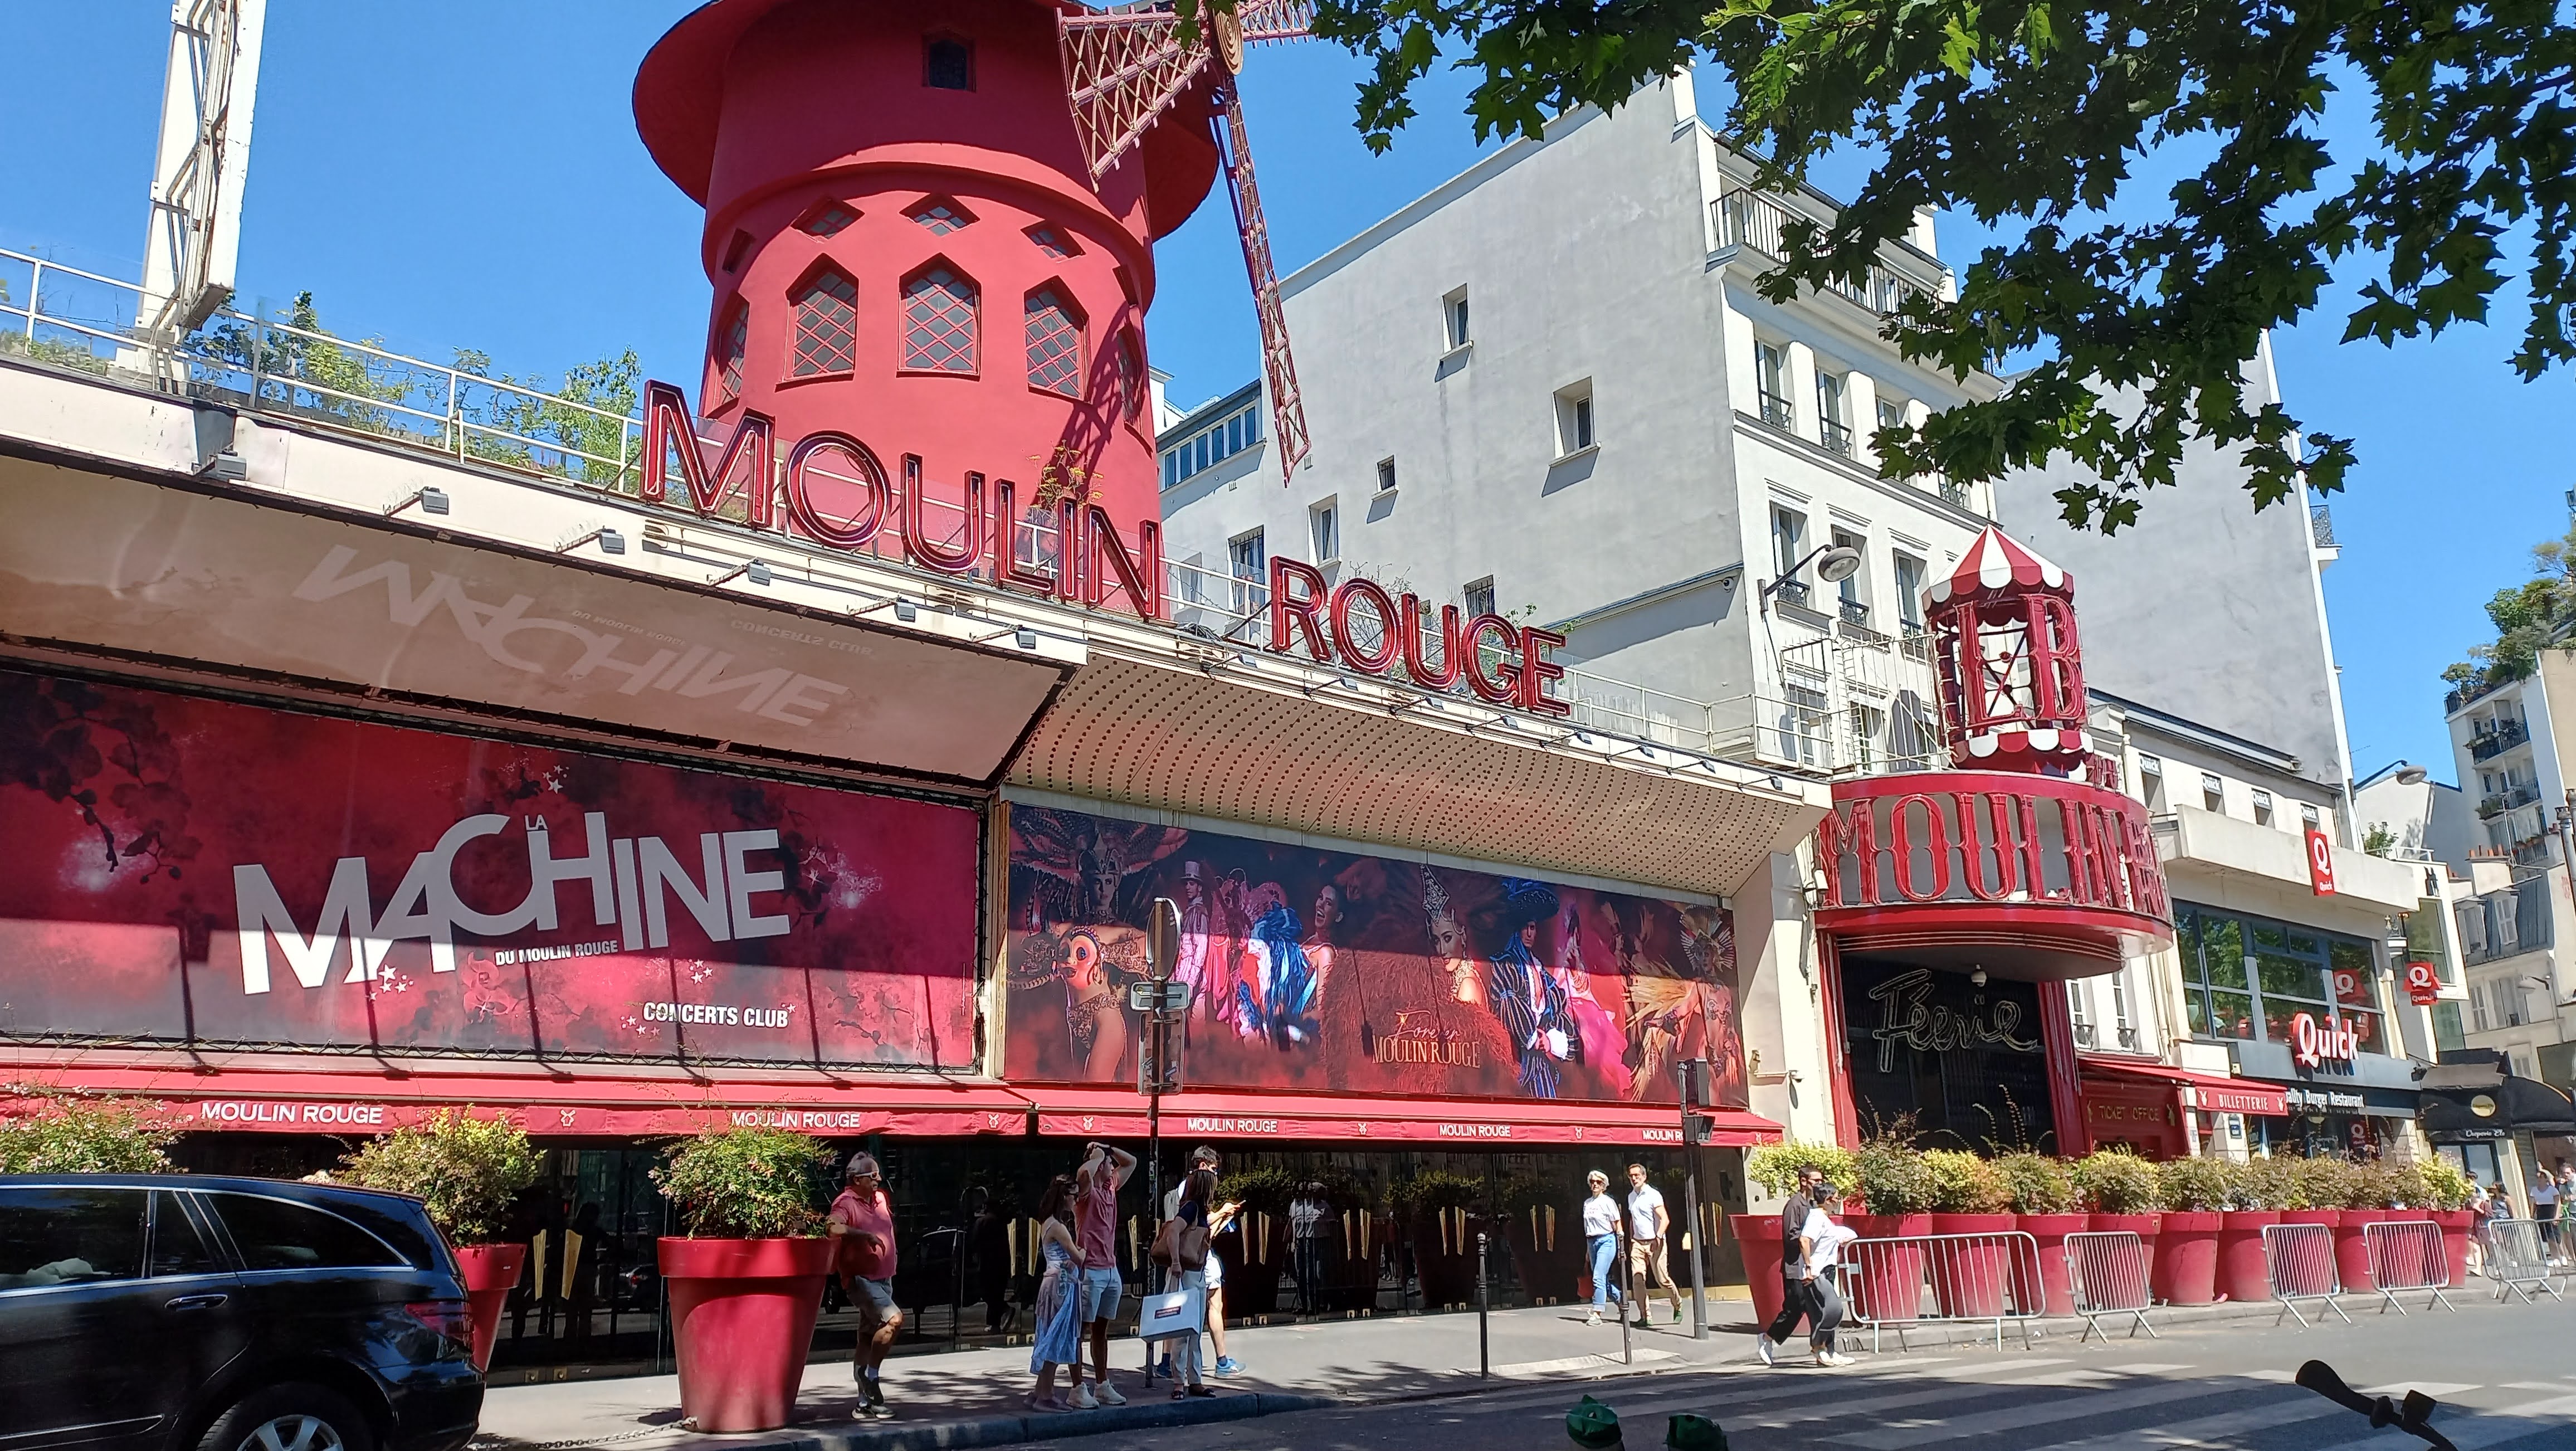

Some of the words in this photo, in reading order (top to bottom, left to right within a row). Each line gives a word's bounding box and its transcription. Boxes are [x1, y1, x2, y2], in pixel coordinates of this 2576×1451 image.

[640, 379, 1160, 621] MOULIN
[1270, 556, 1570, 715] ROUGE
[2140, 757, 2160, 772] Quick
[2202, 775, 2221, 791] Quick
[2251, 790, 2270, 806] Quick
[525, 814, 548, 831] LA
[1815, 792, 2129, 912] MOULIN
[2313, 837, 2330, 876] Q
[233, 811, 791, 995] MACHINE
[495, 950, 515, 966] DU
[519, 944, 571, 963] MOULIN
[575, 940, 618, 957] ROUGE
[2409, 966, 2432, 987] Q
[643, 1002, 738, 1026] CONCERTS
[744, 1008, 788, 1028] CLUB
[1388, 1010, 1460, 1046] Forever
[2292, 1012, 2359, 1068] Quick
[1372, 1035, 1428, 1064] MOULIN
[1431, 1041, 1480, 1069] ROUGE
[2218, 1093, 2268, 1111] BILLETTERIE
[2304, 1089, 2328, 1109] Burger
[2329, 1092, 2364, 1108] Restaurant
[201, 1103, 296, 1123] MOULIN
[303, 1106, 384, 1124] ROUGE
[731, 1112, 798, 1128] MOULIN
[802, 1112, 861, 1128] ROUGE
[2099, 1106, 2125, 1121] TICKET
[2131, 1107, 2160, 1122] OFFICE
[1187, 1118, 1235, 1132] MOULIN
[1237, 1119, 1278, 1133] ROUGE
[1439, 1124, 1476, 1137] MOULIN
[1478, 1126, 1511, 1137] ROUGE
[1642, 1129, 1674, 1141] MOULIN
